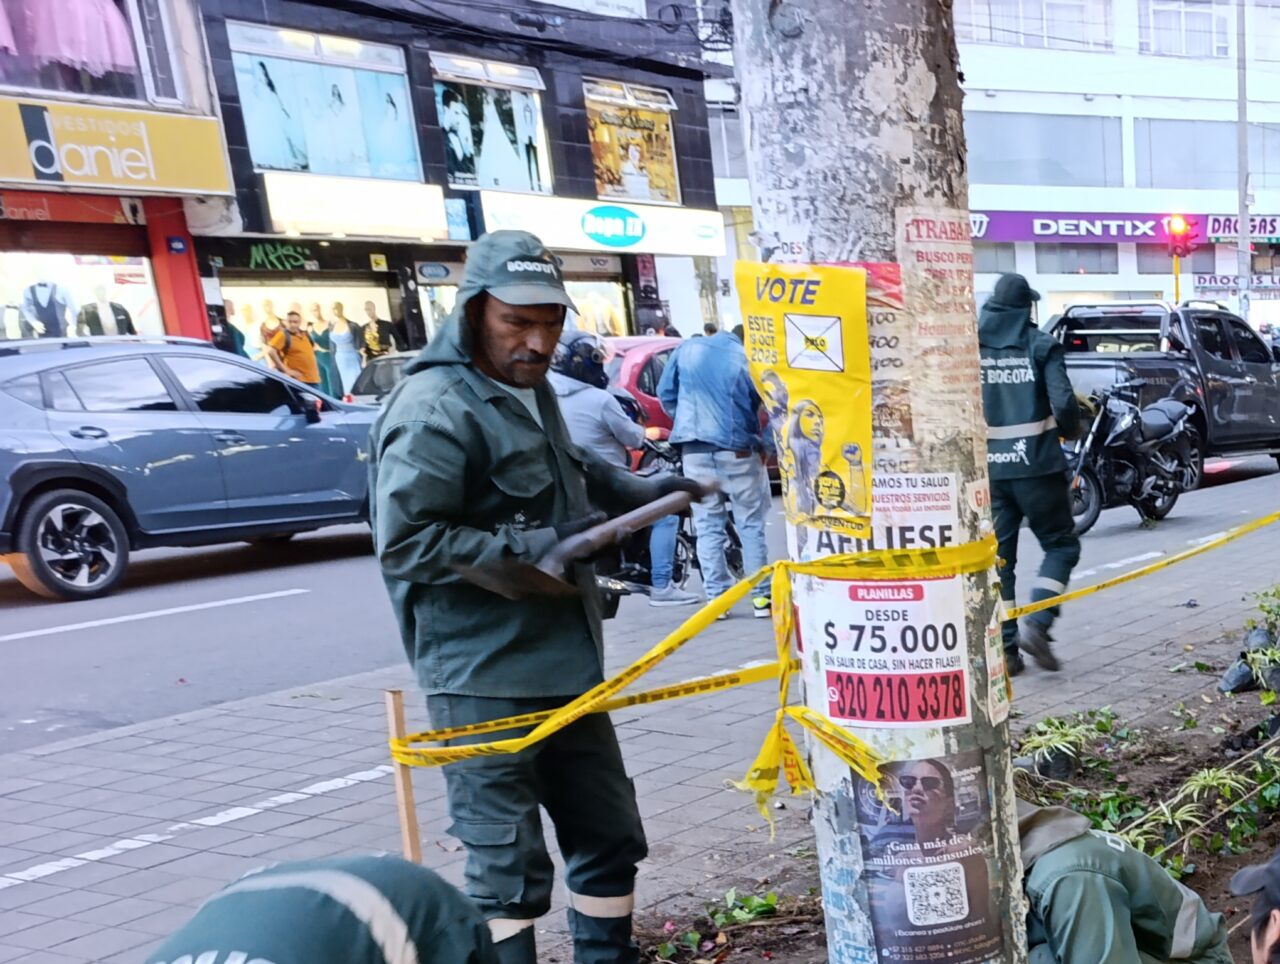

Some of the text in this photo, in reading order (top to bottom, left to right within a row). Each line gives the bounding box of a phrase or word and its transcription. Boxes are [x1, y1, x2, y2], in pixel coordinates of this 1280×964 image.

[29, 111, 156, 180] daniel
[1033, 218, 1156, 236] DENTIX
[916, 250, 954, 263] BUSCO
[756, 276, 821, 305] VOTE
[748, 315, 775, 333] ESTE
[759, 335, 776, 347] OCT
[751, 347, 778, 365] 2025
[905, 477, 917, 489] TU
[921, 477, 950, 488] SALUD
[913, 491, 950, 502] SERVICIOS
[857, 587, 914, 600] PLANILLAS
[865, 609, 909, 622] DESDE
[824, 619, 958, 654] $ 75.000
[825, 654, 835, 666] SIN
[836, 656, 855, 669] SALIR
[857, 658, 867, 670] DE
[892, 659, 905, 670] SIN
[908, 658, 933, 670] HACER
[836, 673, 963, 720] 320 210 3378
[923, 837, 947, 850] más
[951, 834, 964, 846] de
[873, 854, 922, 866] millones
